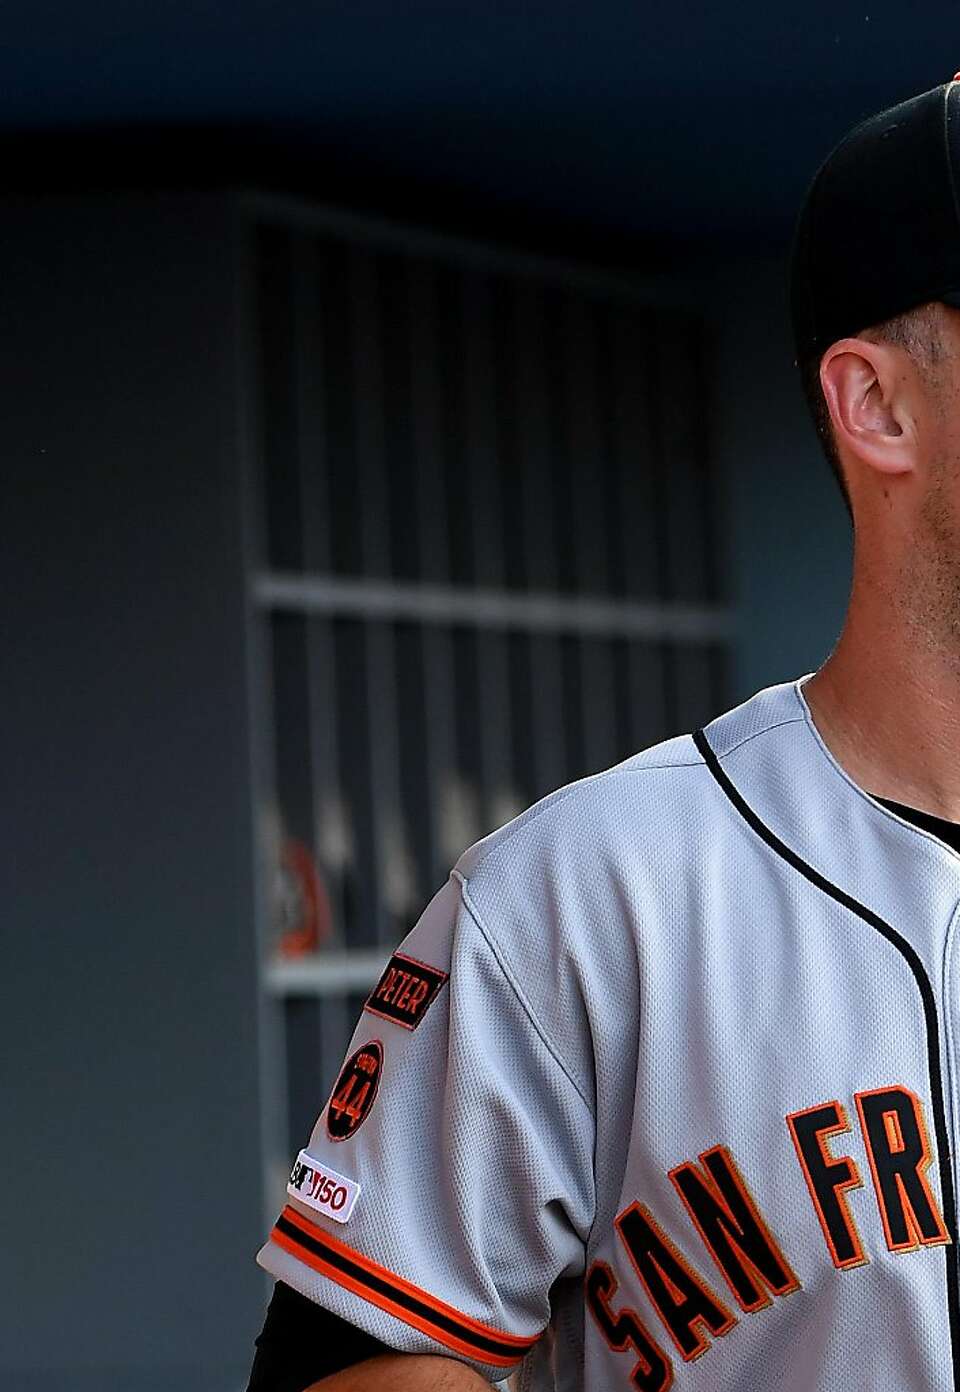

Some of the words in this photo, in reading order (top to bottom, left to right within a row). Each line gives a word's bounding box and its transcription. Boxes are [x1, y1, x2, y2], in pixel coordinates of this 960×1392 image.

[376, 967, 429, 1015] PETER
[332, 1073, 372, 1128] 44
[313, 1175, 348, 1211] 150
